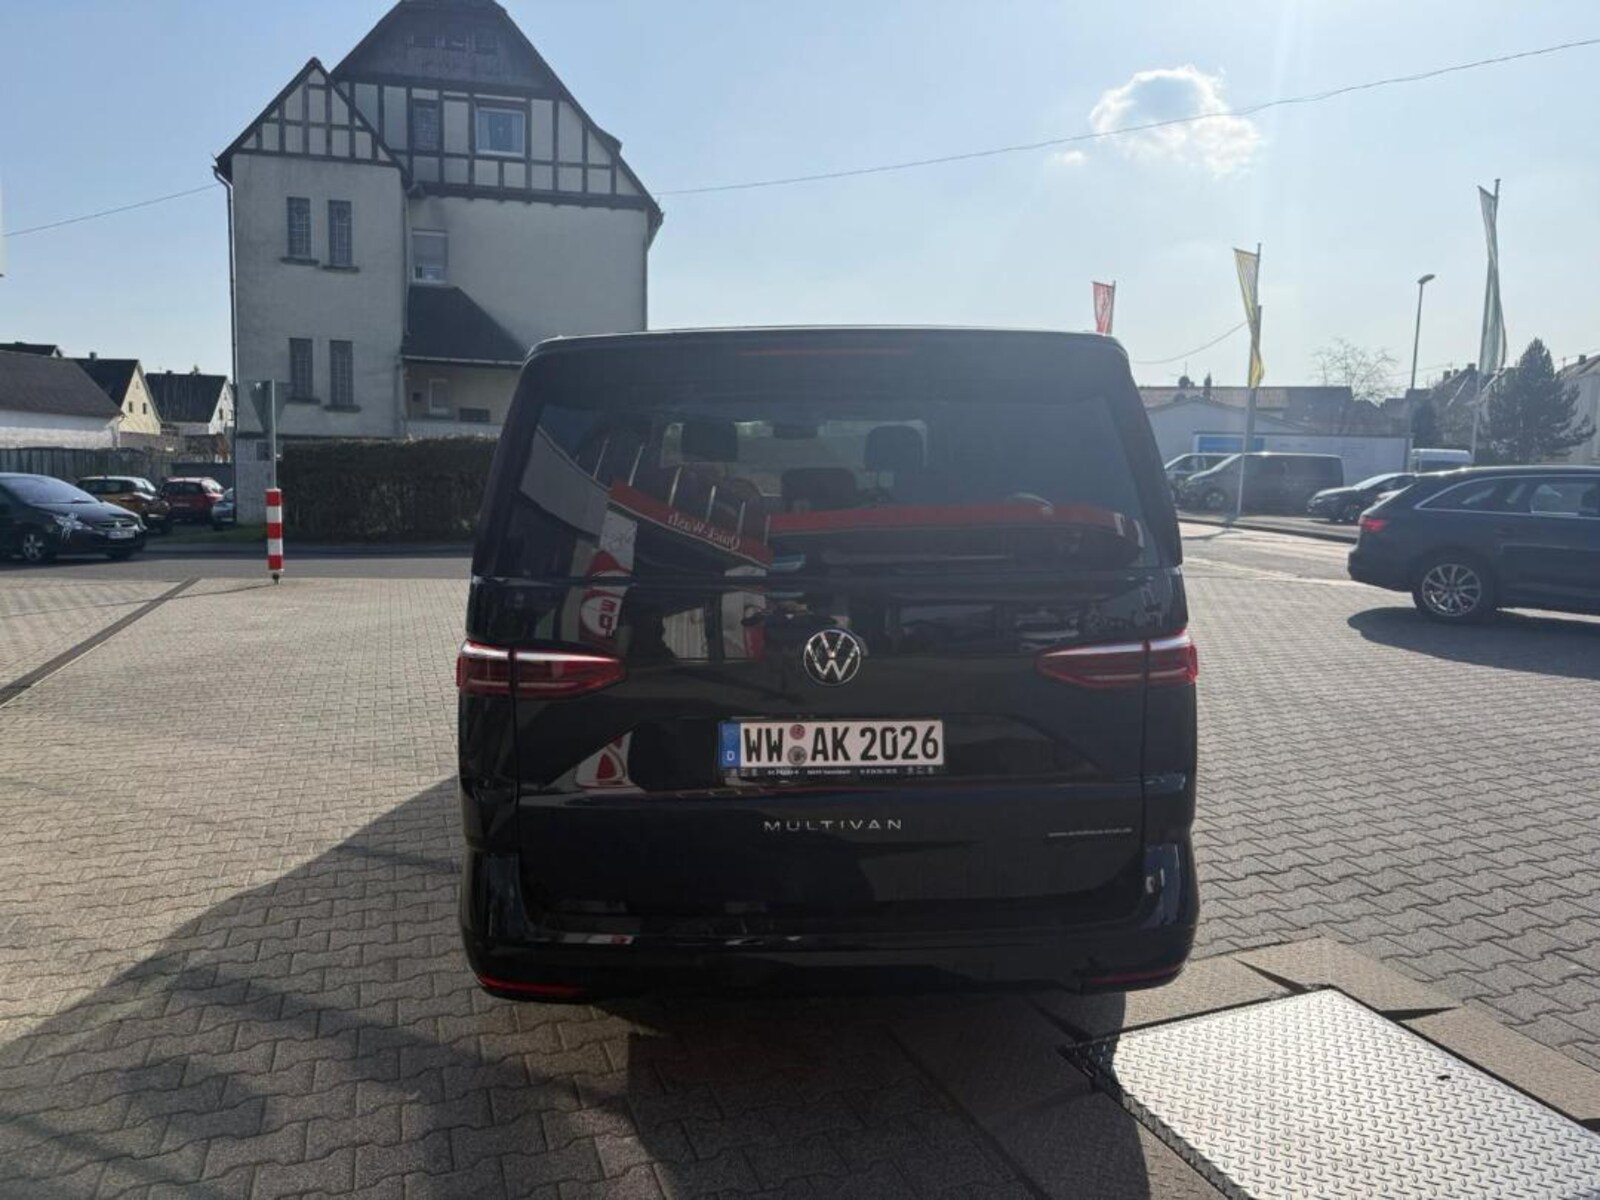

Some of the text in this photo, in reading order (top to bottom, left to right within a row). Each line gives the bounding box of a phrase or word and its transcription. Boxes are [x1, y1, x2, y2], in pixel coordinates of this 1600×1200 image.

[743, 725, 939, 762] WW AK 2026
[763, 818, 902, 832] MULTIVAN
